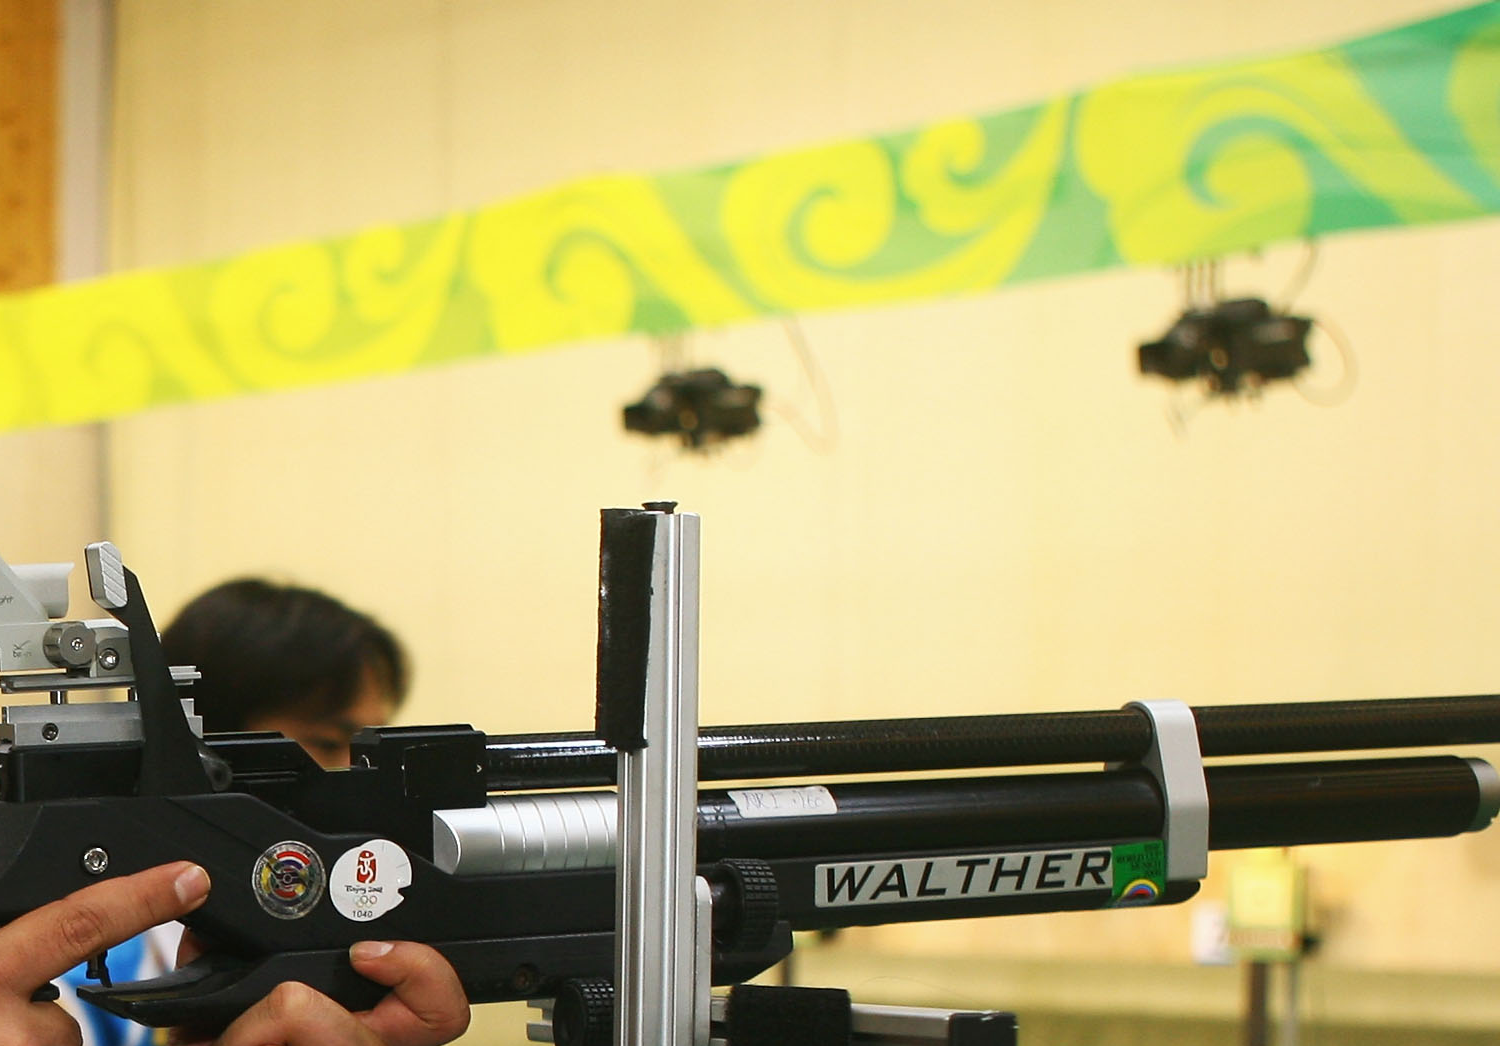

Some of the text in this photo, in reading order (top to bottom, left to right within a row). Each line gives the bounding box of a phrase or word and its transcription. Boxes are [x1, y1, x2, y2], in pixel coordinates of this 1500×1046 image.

[826, 851, 1112, 903] WALTHER
[345, 885, 383, 894] Beijing 2008
[352, 910, 373, 919] 1040
